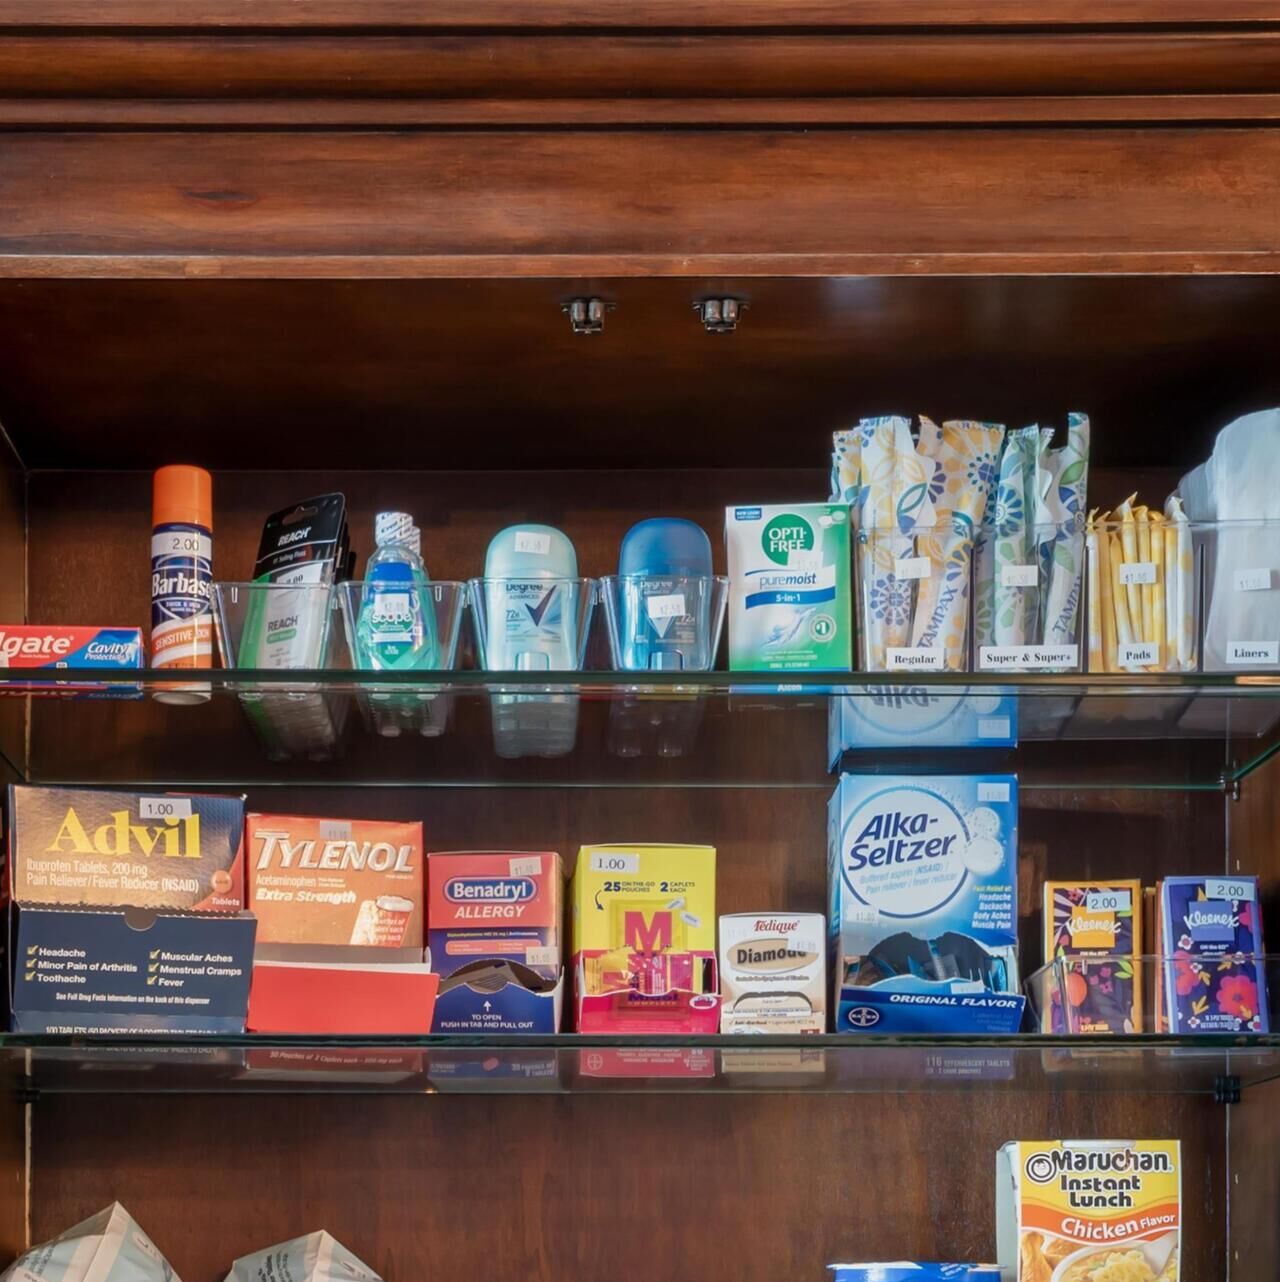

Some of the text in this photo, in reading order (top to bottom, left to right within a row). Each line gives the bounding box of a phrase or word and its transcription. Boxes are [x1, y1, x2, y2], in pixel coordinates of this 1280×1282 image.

[278, 527, 311, 545] REACH
[172, 538, 199, 551] 2.00
[770, 540, 805, 552] FREE
[760, 573, 816, 590] puremoist
[776, 594, 801, 602] 5-in-1
[268, 615, 298, 632] REACH
[372, 612, 413, 625] scope
[916, 585, 958, 649] TAMPAX
[894, 654, 936, 666] Regular
[987, 653, 1017, 665] Super
[1022, 653, 1030, 662] &
[1125, 649, 1151, 662] Pads
[1234, 647, 1269, 660] Liners
[147, 803, 174, 816] 1.00
[44, 806, 202, 858] Advil
[855, 812, 938, 843] Alka-
[255, 831, 414, 873] TYLENOL
[848, 834, 957, 871] Seltzer
[27, 858, 148, 878] Ibuprofen Tablets, 200 mg
[599, 858, 625, 870] 1.00
[27, 874, 47, 886] Pain
[120, 877, 159, 891] Reducer
[161, 878, 199, 893] (NSAID)
[256, 875, 316, 888] Acetaminophen
[256, 888, 356, 905] Extra Strength
[453, 882, 527, 901] Benadryl
[979, 902, 1011, 910] Backache
[1091, 897, 1117, 910] 2.00
[455, 905, 525, 919] ALLERGY
[973, 911, 1011, 921] Body Aches
[972, 920, 1011, 929] Muscle Pain
[1065, 917, 1121, 936] Kleenex
[1183, 911, 1239, 930] Kleenex
[39, 948, 86, 958] Headache
[161, 951, 233, 963] Muscular Aches
[37, 960, 138, 972] Minor Pain of Arthritis
[160, 965, 242, 976] Menstrual Cramps
[37, 973, 86, 984] Toothache
[158, 978, 184, 987] Fever
[890, 994, 1017, 1009] ORIGINAL FLAVOR
[1051, 1149, 1168, 1172] Maruchan
[1061, 1174, 1140, 1193] Instant
[1070, 1192, 1132, 1208] Lunch
[1061, 1213, 1175, 1240] Chicken Flavor
